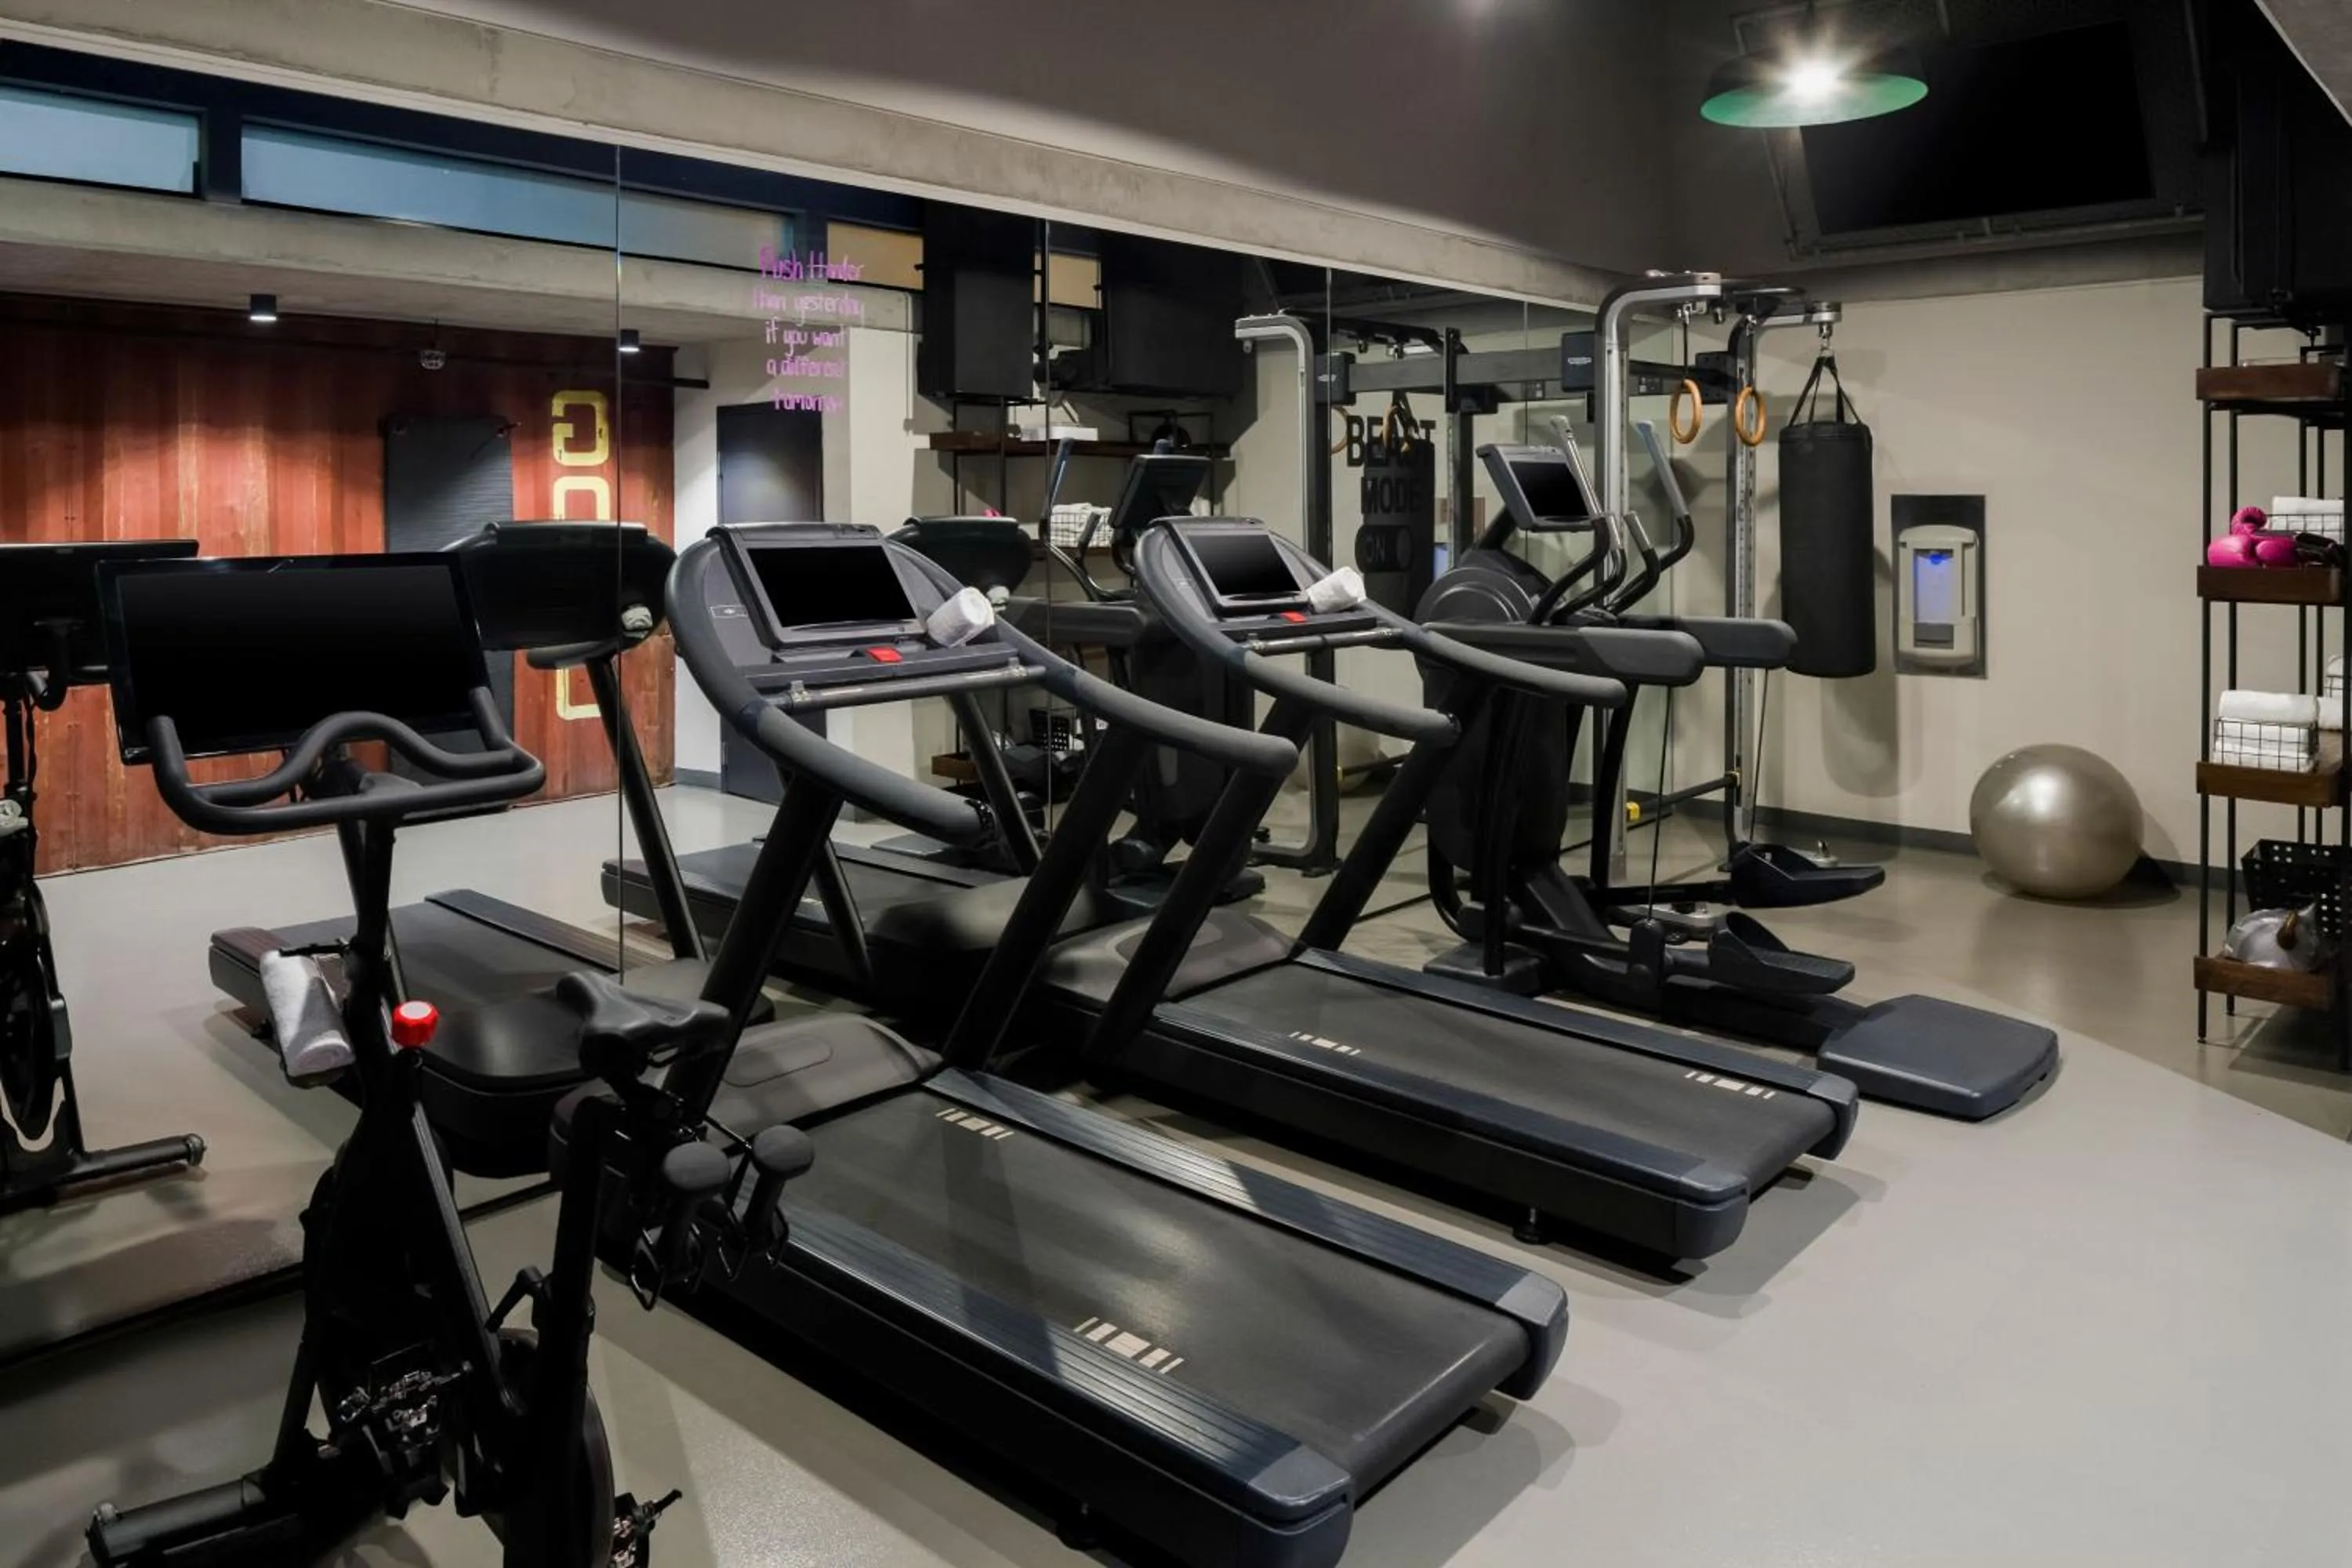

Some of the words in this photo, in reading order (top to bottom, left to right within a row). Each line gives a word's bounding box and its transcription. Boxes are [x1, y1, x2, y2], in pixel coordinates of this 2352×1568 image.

[759, 246, 803, 281] Push
[765, 315, 779, 344] if
[783, 329, 808, 357] you
[812, 324, 845, 347] want
[1364, 535, 1385, 564] ON
